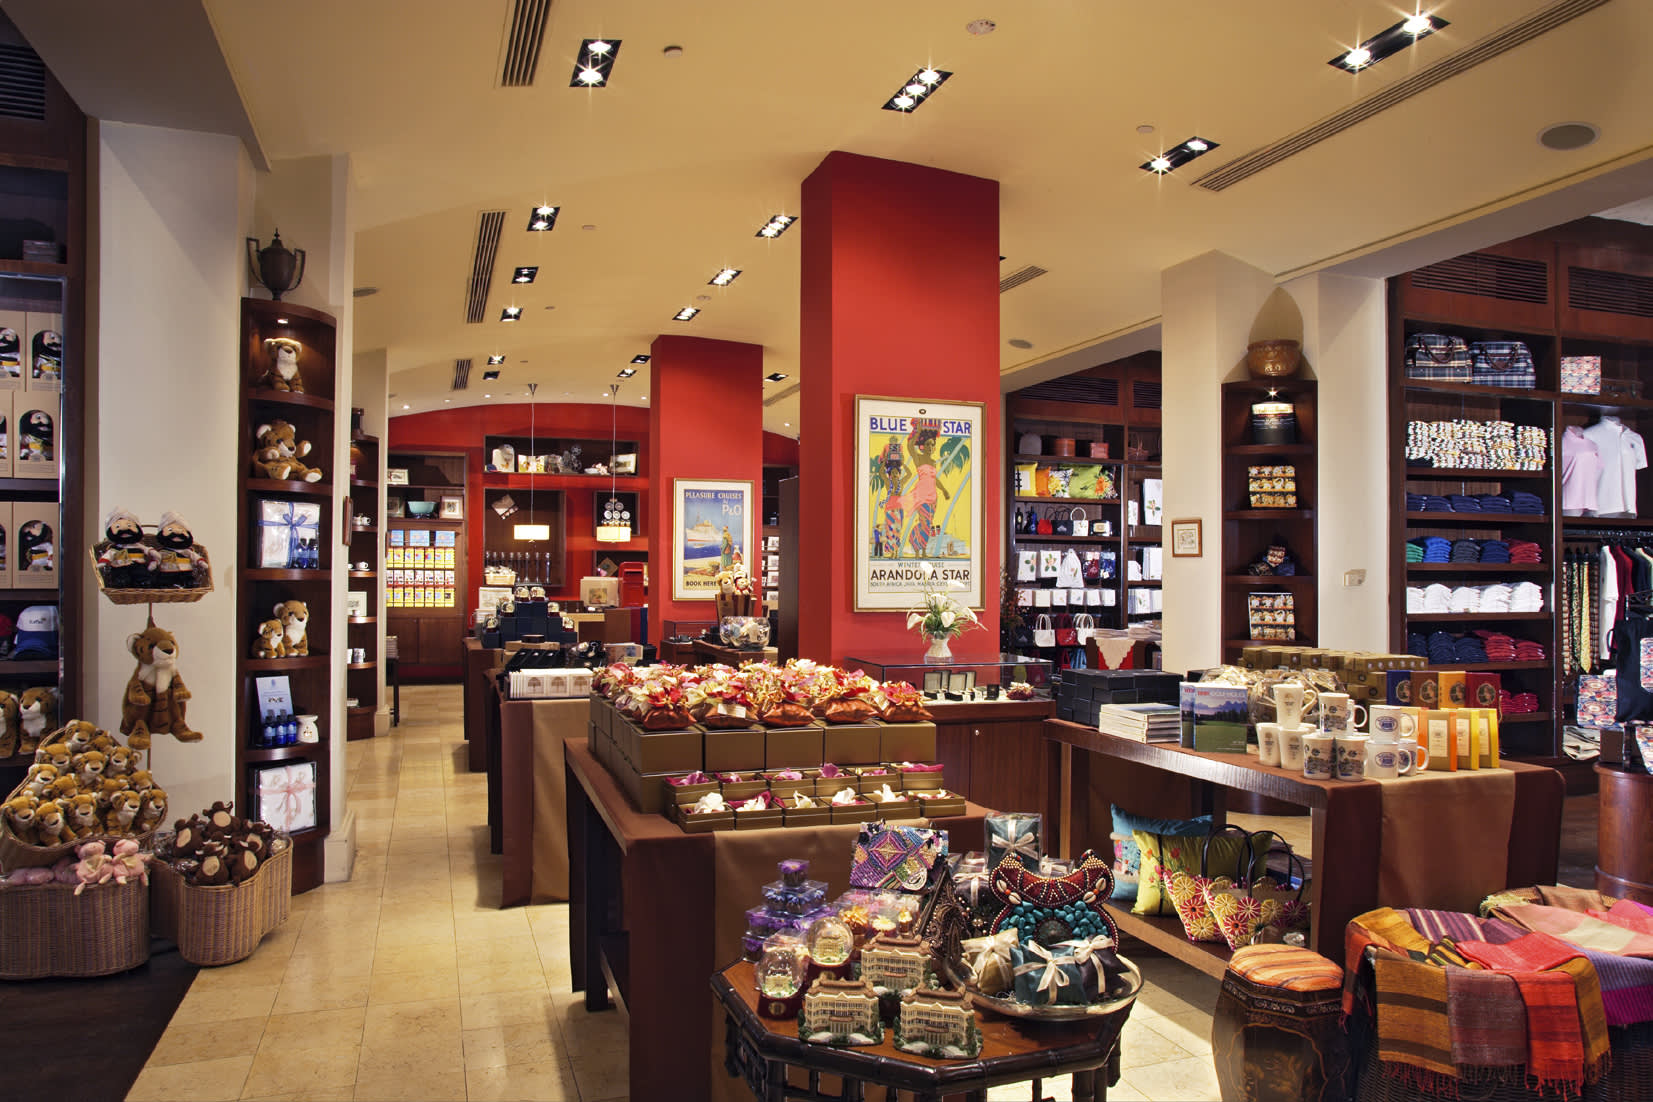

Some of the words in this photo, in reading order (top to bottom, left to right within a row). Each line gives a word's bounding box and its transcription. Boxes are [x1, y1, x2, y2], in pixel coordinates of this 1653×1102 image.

[870, 417, 907, 431] BLUE
[943, 421, 971, 434] STAR
[685, 491, 715, 499] PLEASURE
[942, 569, 970, 581] STAR
